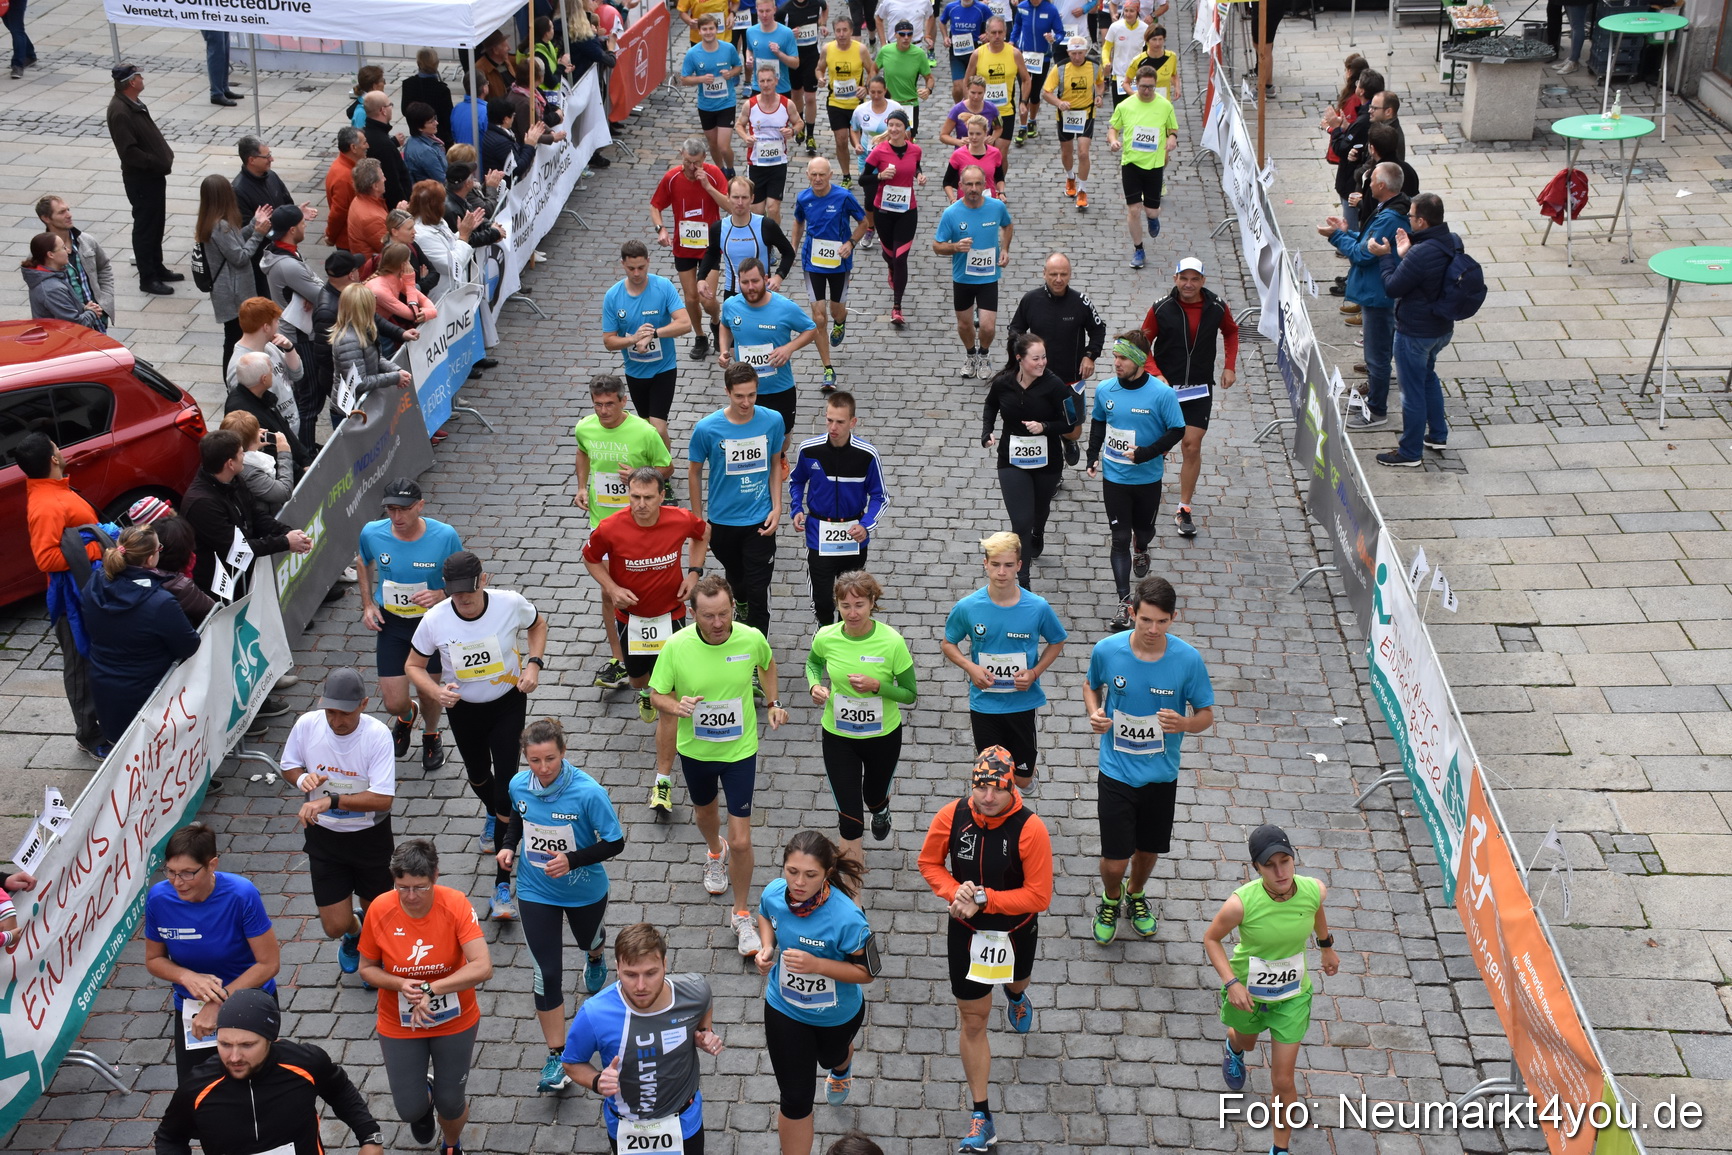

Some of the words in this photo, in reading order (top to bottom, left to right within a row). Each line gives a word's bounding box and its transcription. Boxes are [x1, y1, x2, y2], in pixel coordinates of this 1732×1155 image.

[123, 4, 178, 20] Vernetzt,
[180, 10, 199, 20] um
[202, 10, 221, 22] frei
[225, 13, 239, 23] zu
[241, 15, 270, 25] sein.
[799, 30, 815, 38] 2313
[706, 82, 723, 91] 2497
[837, 86, 854, 94] 2310
[986, 91, 1004, 99] 2434
[1136, 133, 1155, 142] 2294
[760, 149, 779, 157] 2366
[886, 194, 906, 203] 2274
[685, 229, 702, 239] 200
[818, 247, 835, 258] 429
[971, 256, 992, 266] 2216
[589, 439, 629, 452] NOVINA
[1108, 436, 1130, 452] 2066
[590, 453, 629, 463] HOTELS
[731, 448, 761, 463] 2186
[1014, 446, 1043, 459] 2363
[741, 476, 752, 485] 18.
[605, 483, 627, 495] 193
[625, 552, 678, 567] FACKELMANN
[393, 593, 412, 606] 13
[641, 626, 658, 640] 50
[1007, 631, 1030, 639] BOCK
[462, 651, 491, 668] 229
[1148, 687, 1175, 699] BOCK
[700, 711, 736, 727] 2304
[840, 707, 876, 723] 2305
[1120, 725, 1156, 740] 2444
[551, 812, 579, 821] BOCK
[531, 836, 568, 852] 2268
[799, 937, 825, 947] BOCK
[979, 947, 1006, 964] 410
[392, 963, 445, 973] funrunners
[1256, 969, 1297, 985] 2246
[1522, 952, 1543, 999] Neumarkts
[786, 973, 827, 993] 2378
[626, 1134, 673, 1150] 2070
